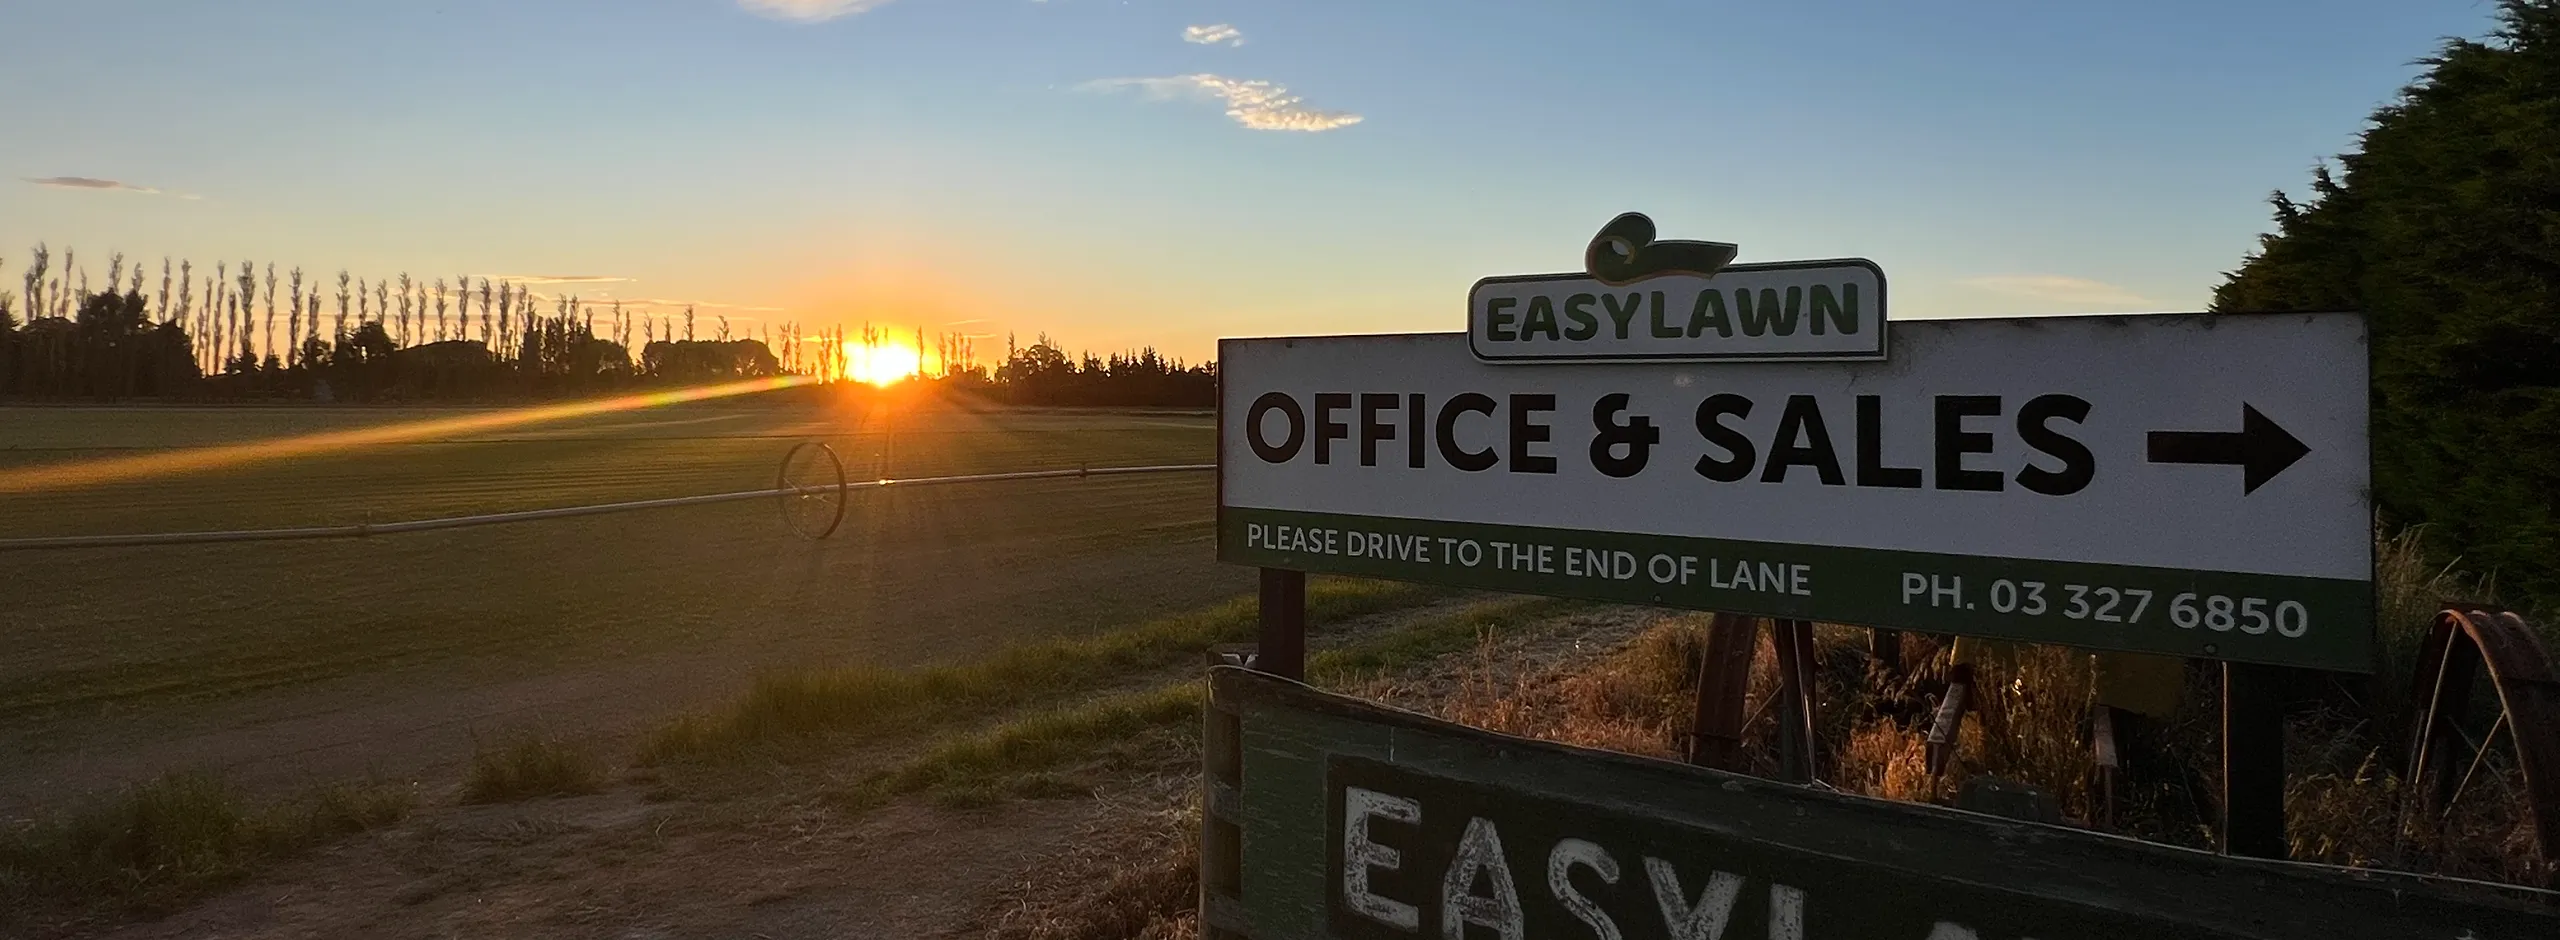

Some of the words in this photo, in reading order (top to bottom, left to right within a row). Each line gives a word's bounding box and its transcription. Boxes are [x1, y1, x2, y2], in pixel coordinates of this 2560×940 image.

[1487, 283, 1859, 341] EASYLAWN
[1246, 392, 1557, 473] OFFICE
[1589, 393, 1660, 478] &
[1694, 393, 2095, 496] SALES
[1247, 522, 1339, 556] PLEASE
[1347, 531, 1431, 564] DRIVE
[1438, 537, 1483, 568] TO
[1490, 541, 1555, 575] THE
[1565, 547, 1637, 581] END
[1648, 554, 1698, 588] OF
[1709, 559, 1812, 596] LANE
[1902, 572, 1976, 611] PH.
[1990, 579, 2047, 616] 03
[2063, 584, 2153, 625] 327
[2169, 592, 2309, 639] 6850
